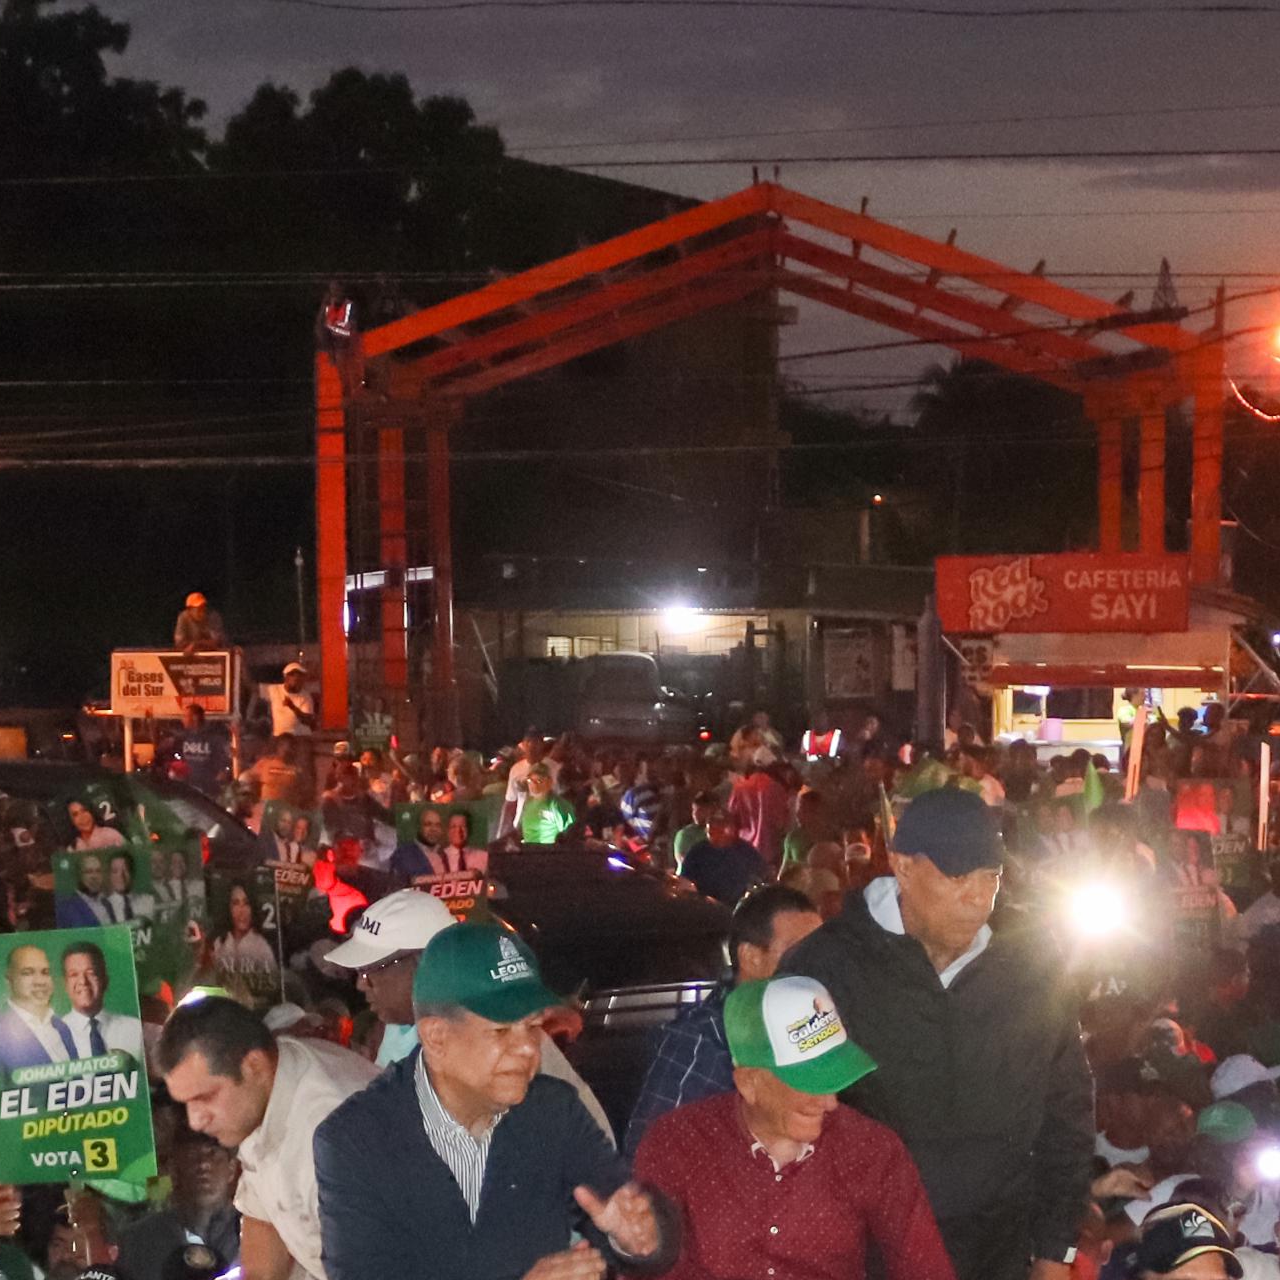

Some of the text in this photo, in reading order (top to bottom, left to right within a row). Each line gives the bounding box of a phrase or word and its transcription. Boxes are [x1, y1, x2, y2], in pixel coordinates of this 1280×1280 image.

[969, 557, 1030, 600] Red
[969, 577, 1048, 631] Rock
[1090, 593, 1157, 620] SAYI
[122, 683, 164, 697] del Sur
[127, 670, 164, 683] Gases
[99, 801, 116, 820] 2
[430, 880, 483, 899] EDEN
[262, 903, 277, 929] 2
[19, 1055, 120, 1084] JOHAN MATOS
[0, 1071, 138, 1119] EL EDEN
[23, 1107, 129, 1140] DIPUTADO
[30, 1141, 109, 1168] VOTA 3
